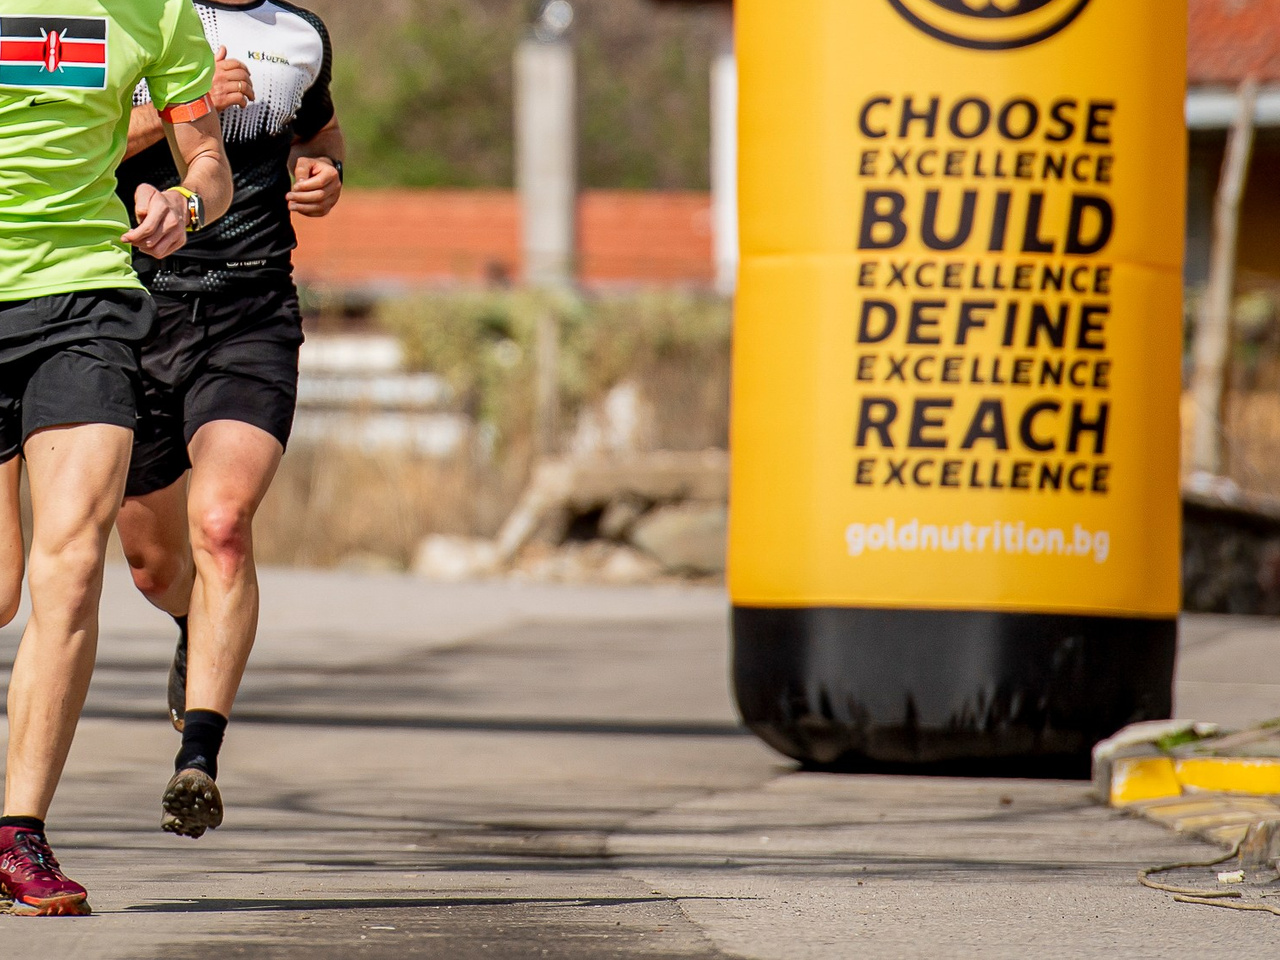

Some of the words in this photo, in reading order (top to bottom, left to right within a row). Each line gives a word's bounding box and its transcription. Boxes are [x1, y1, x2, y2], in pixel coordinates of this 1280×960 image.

[266, 54, 290, 66] ULTRA
[858, 95, 1117, 145] CHOOSE
[857, 149, 1116, 183] EXCELLENCE
[857, 189, 1116, 256] BUILD
[856, 261, 1114, 294] EXCELLENCE
[856, 298, 1113, 352] DEFINE
[855, 354, 1113, 389] EXCELLENCE
[855, 396, 1111, 455] REACH
[854, 458, 1112, 493] EXCELLENCE
[846, 518, 1111, 564] goldnutrition.bg
